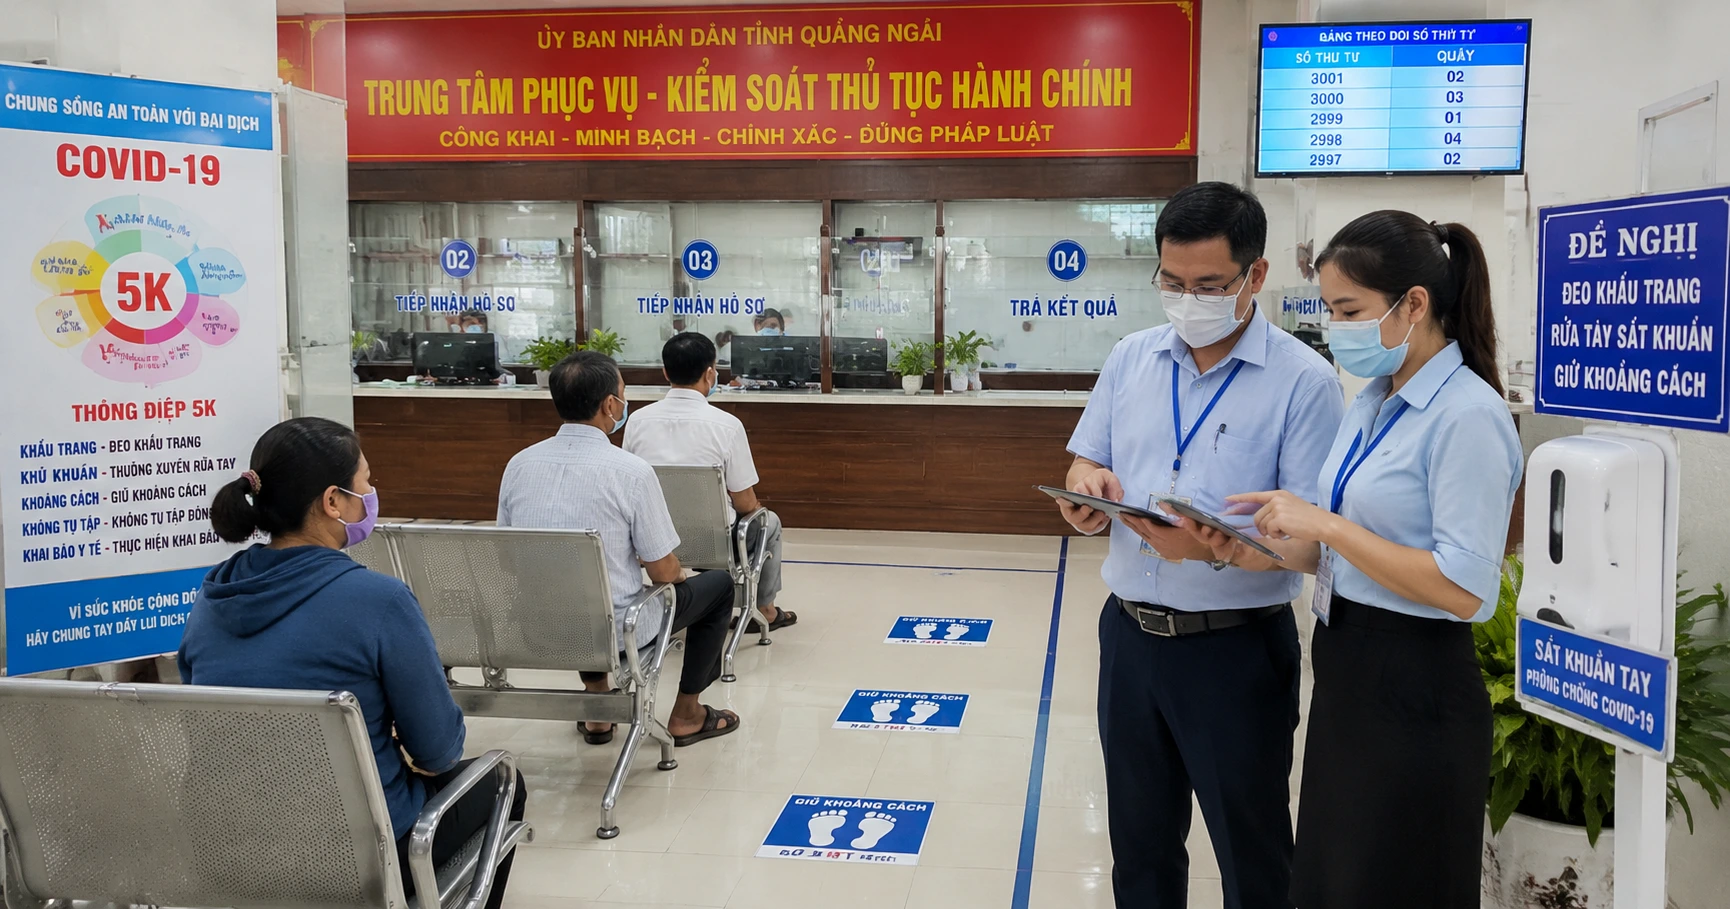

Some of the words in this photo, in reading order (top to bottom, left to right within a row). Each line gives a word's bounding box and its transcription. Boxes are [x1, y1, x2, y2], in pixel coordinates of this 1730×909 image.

[572, 30, 616, 49] BAN
[1355, 30, 1386, 42] THEO
[1311, 72, 1344, 85] 3001
[1446, 70, 1465, 83] 02
[363, 78, 449, 116] TRUNG
[456, 69, 514, 115] TÂM
[523, 75, 595, 122] PHỤC
[603, 75, 638, 121] VỤ
[647, 92, 657, 100] -
[667, 57, 737, 113] KIỂM
[746, 65, 818, 112] SOÁT
[827, 57, 880, 111] THỦ
[889, 71, 942, 118] TỤC
[952, 61, 1032, 109] HÀNH
[1041, 59, 1132, 109] CHÍNH
[1310, 92, 1344, 105] 3000
[1445, 90, 1464, 103] 03
[5, 92, 58, 114] CHUNG
[107, 103, 128, 121] AN
[228, 114, 259, 134] DỊCH
[1310, 112, 1344, 125] 2999
[1444, 111, 1462, 124] 01
[439, 125, 500, 148] CÔNG
[506, 130, 555, 147] KHAI
[637, 128, 696, 150] BẠCH
[1309, 133, 1343, 146] 2998
[1443, 132, 1462, 145] 04
[56, 142, 221, 186] COVID-19
[1309, 153, 1342, 166] 2997
[1443, 152, 1461, 165] 02
[1617, 222, 1698, 260] NGHỊ
[445, 249, 470, 270] 02
[688, 249, 713, 272] 03
[1053, 249, 1079, 272] 04
[116, 271, 173, 312] 5K
[1562, 281, 1591, 305] ĐEO
[1643, 277, 1701, 305] TRANG
[191, 398, 217, 418] 5K
[57, 441, 97, 456] TRANG
[166, 436, 201, 449] TRANG
[216, 457, 236, 471] TAY
[23, 545, 50, 563] KHAI
[78, 542, 86, 557] Y
[172, 533, 196, 548] KHAI
[52, 625, 91, 644] CHUNG
[93, 622, 113, 638] TAY
[1619, 664, 1652, 698] TAY
[1601, 695, 1654, 735] COVID-19
